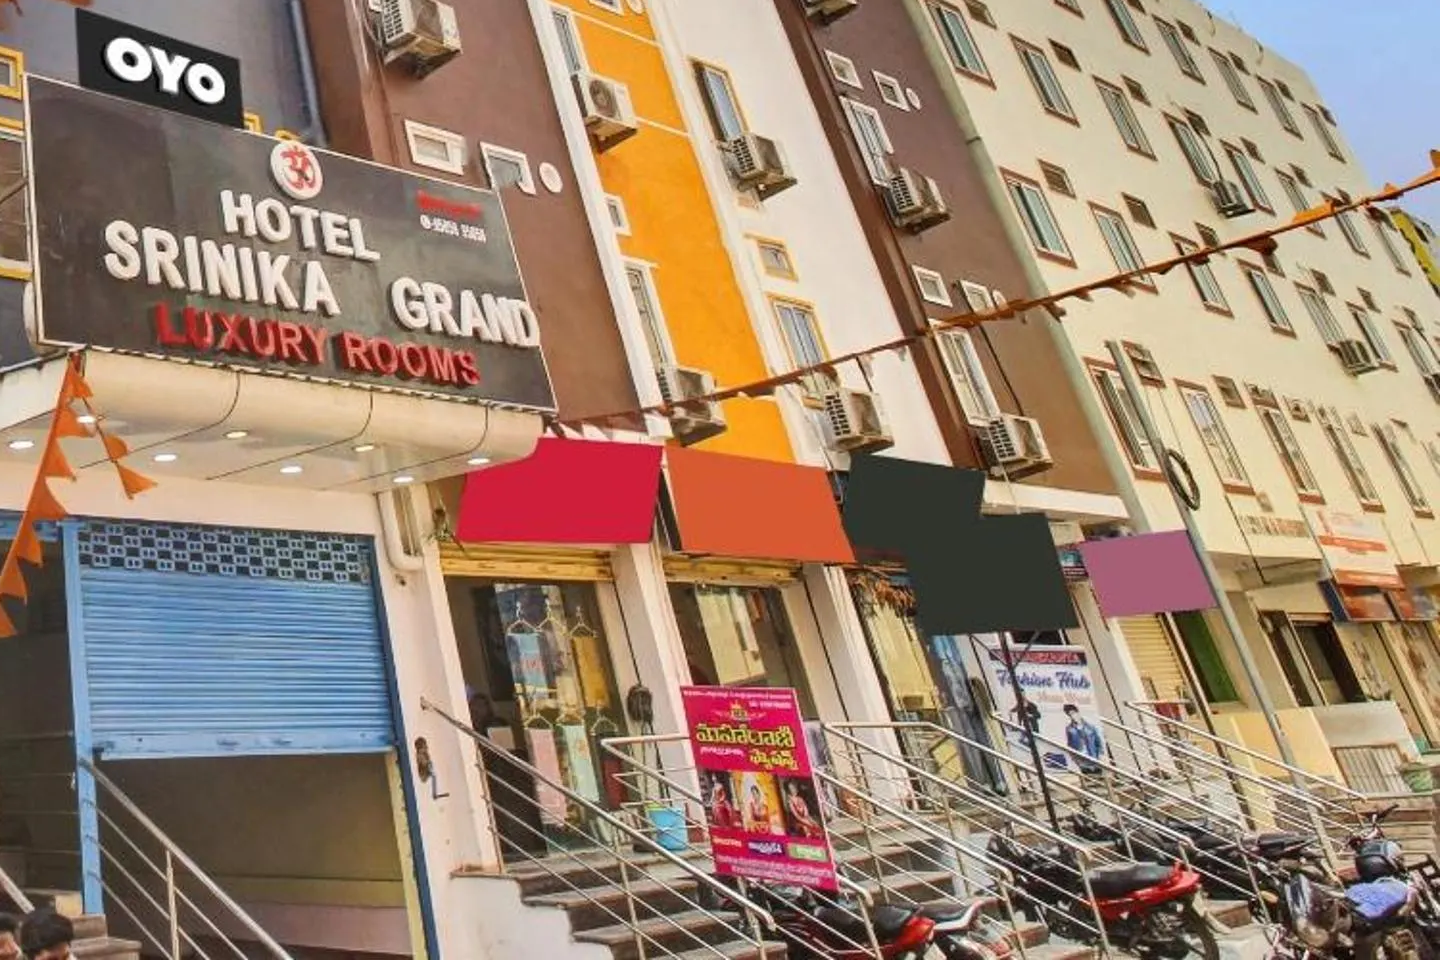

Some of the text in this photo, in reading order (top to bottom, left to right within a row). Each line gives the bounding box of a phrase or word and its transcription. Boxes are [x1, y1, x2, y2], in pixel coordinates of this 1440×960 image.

[104, 36, 226, 105] OYO
[219, 189, 381, 262] HOTEL
[103, 219, 541, 348] SRINIKA GRAND
[153, 300, 483, 387] LUXURY ROOMS
